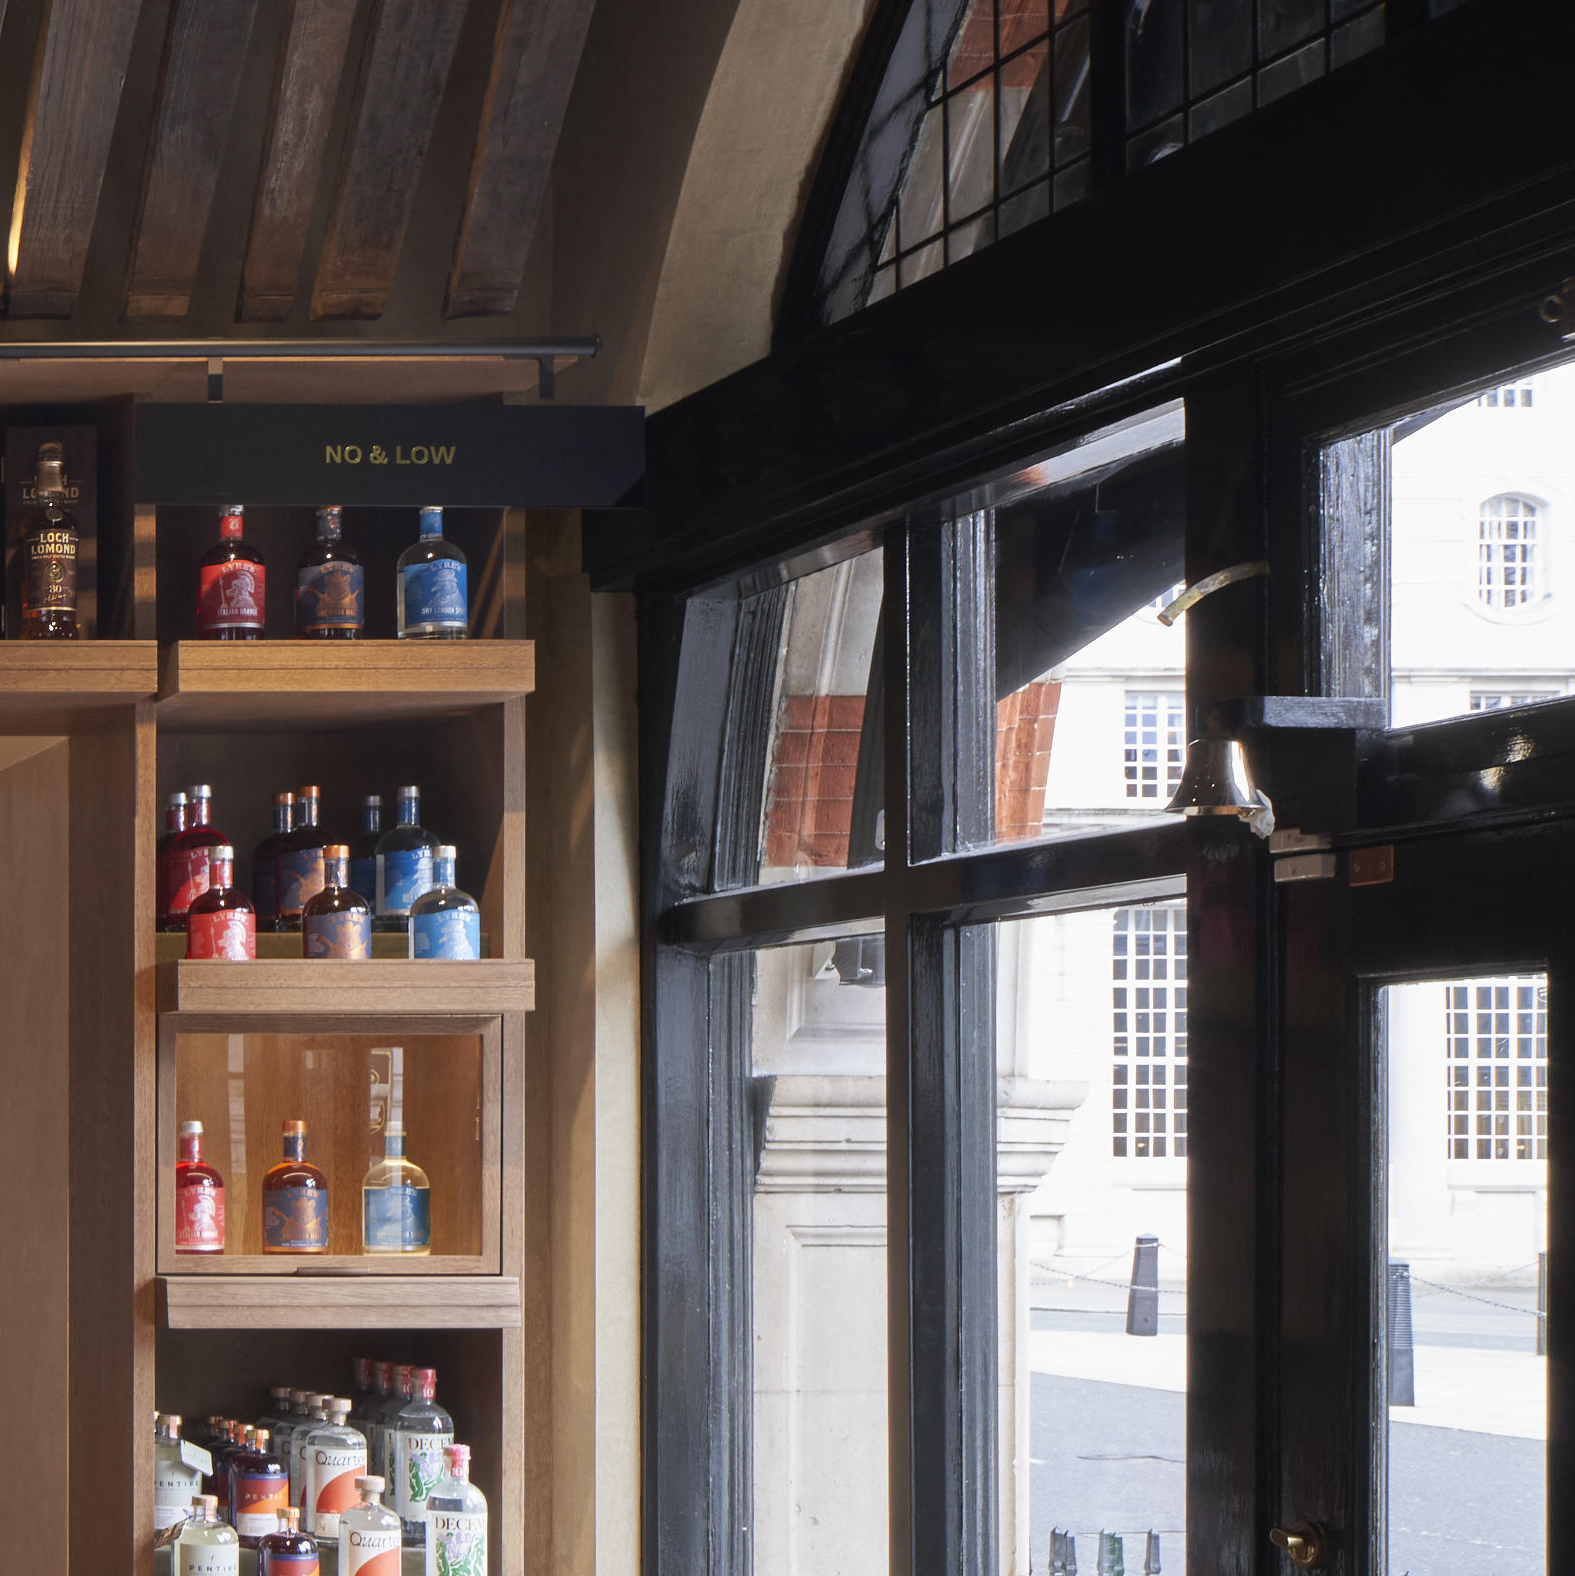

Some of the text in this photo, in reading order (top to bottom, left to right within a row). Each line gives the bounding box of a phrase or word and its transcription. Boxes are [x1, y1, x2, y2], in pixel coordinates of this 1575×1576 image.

[325, 445, 456, 466] NO & LOW
[39, 534, 69, 543] LOCH
[31, 543, 77, 555] LOMOND
[49, 585, 62, 593] 30
